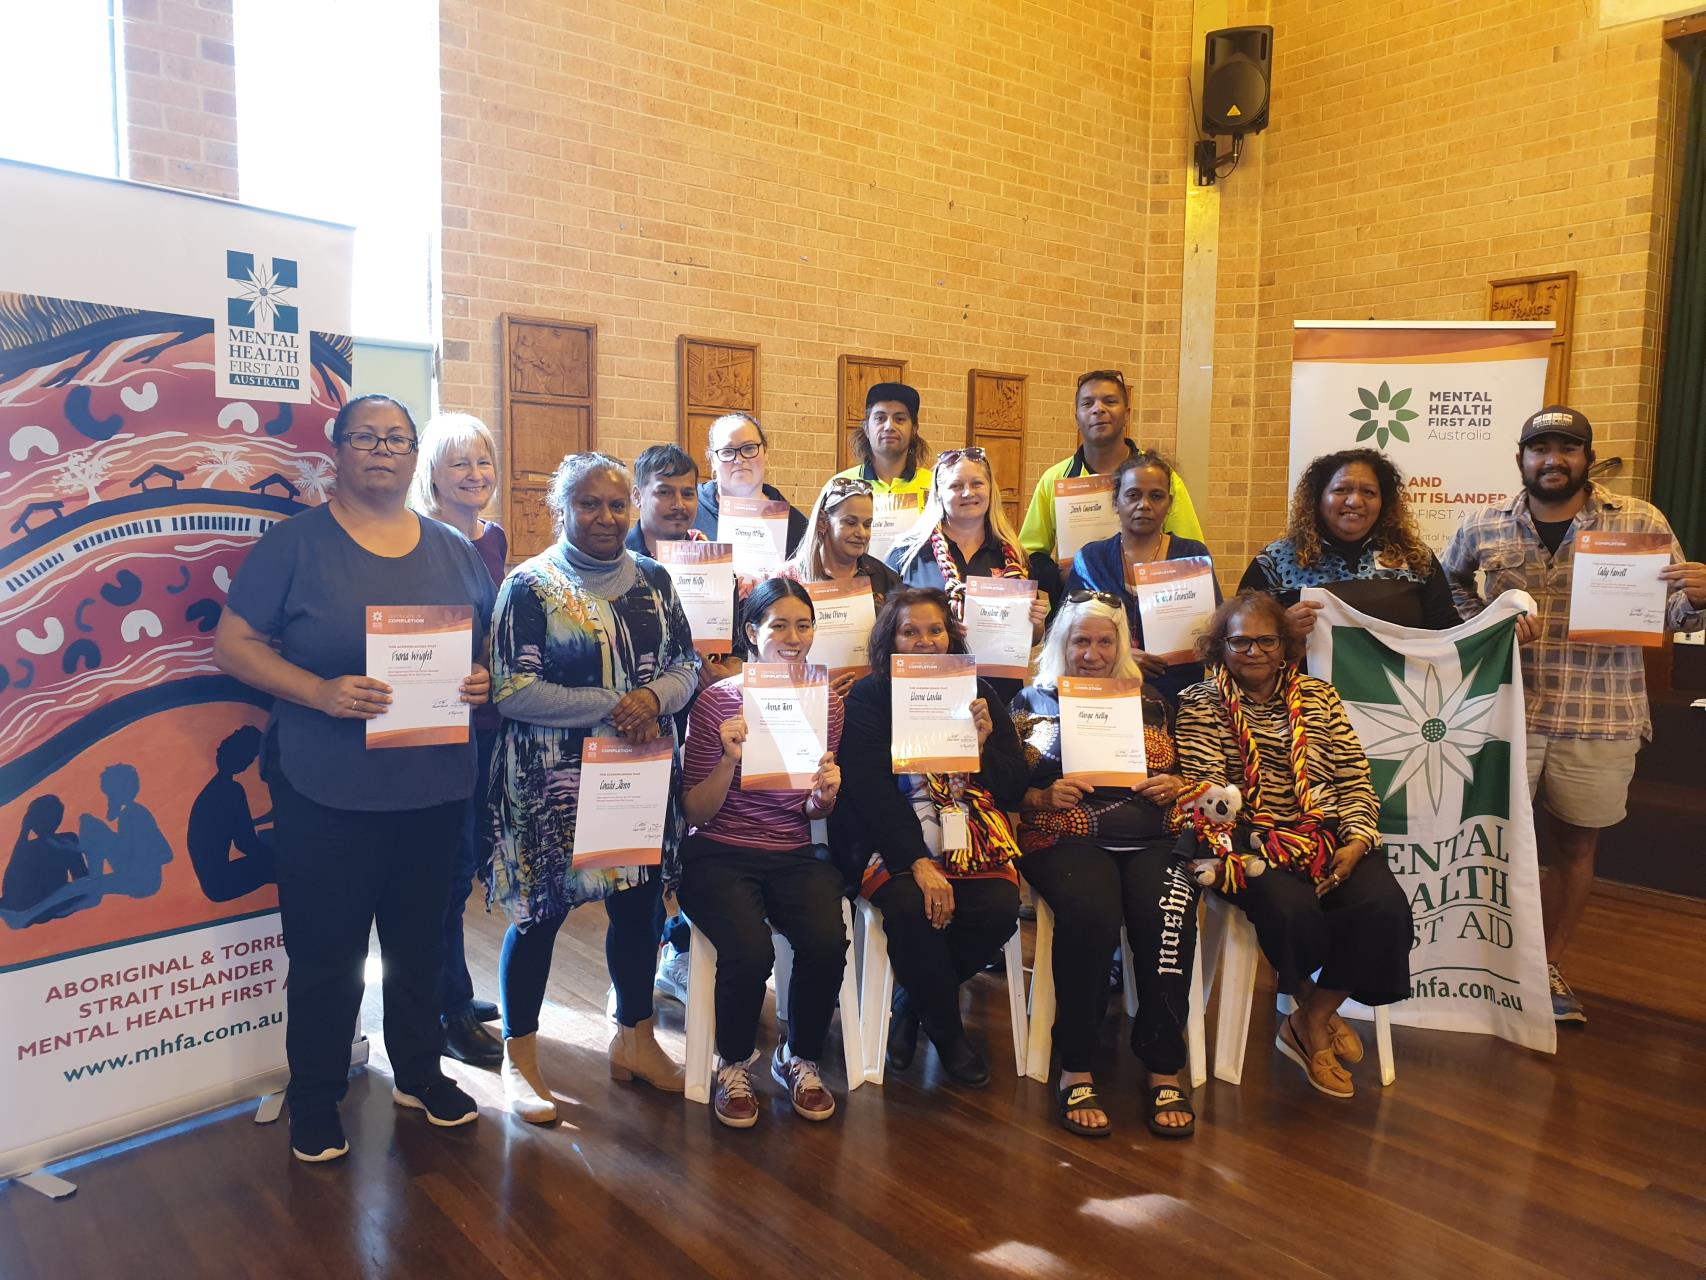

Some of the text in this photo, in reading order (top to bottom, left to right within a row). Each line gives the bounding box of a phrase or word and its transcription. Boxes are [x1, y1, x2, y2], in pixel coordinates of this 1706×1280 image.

[229, 328, 299, 348] MENTAL
[229, 344, 298, 363] HEALTH
[230, 360, 299, 377] FIRST AID
[233, 375, 297, 389] AUSTRALIA
[1429, 391, 1492, 402] MENTAL
[1429, 404, 1492, 415] HEALTH
[1428, 418, 1491, 427] FIRST AID
[1428, 429, 1491, 441] Australia
[1408, 476, 1442, 487] AND
[1403, 493, 1426, 503] AIT
[1418, 510, 1454, 520] FIRST
[1387, 823, 1509, 875] ENTAL
[1411, 865, 1511, 914] ALTH
[1457, 911, 1514, 949] AID
[45, 933, 285, 1003] ABORIGINAL & TORRE
[79, 986, 164, 1018] STRAIT
[171, 958, 274, 997] ISLANDER
[17, 1021, 119, 1061] MENTAL
[126, 996, 215, 1032] HEALTH
[221, 979, 277, 1006] FIRST
[63, 1010, 283, 1083] www.mhfa.com.au
[1071, 1086, 1093, 1098] NIKE
[1159, 1089, 1180, 1099] NIKE
